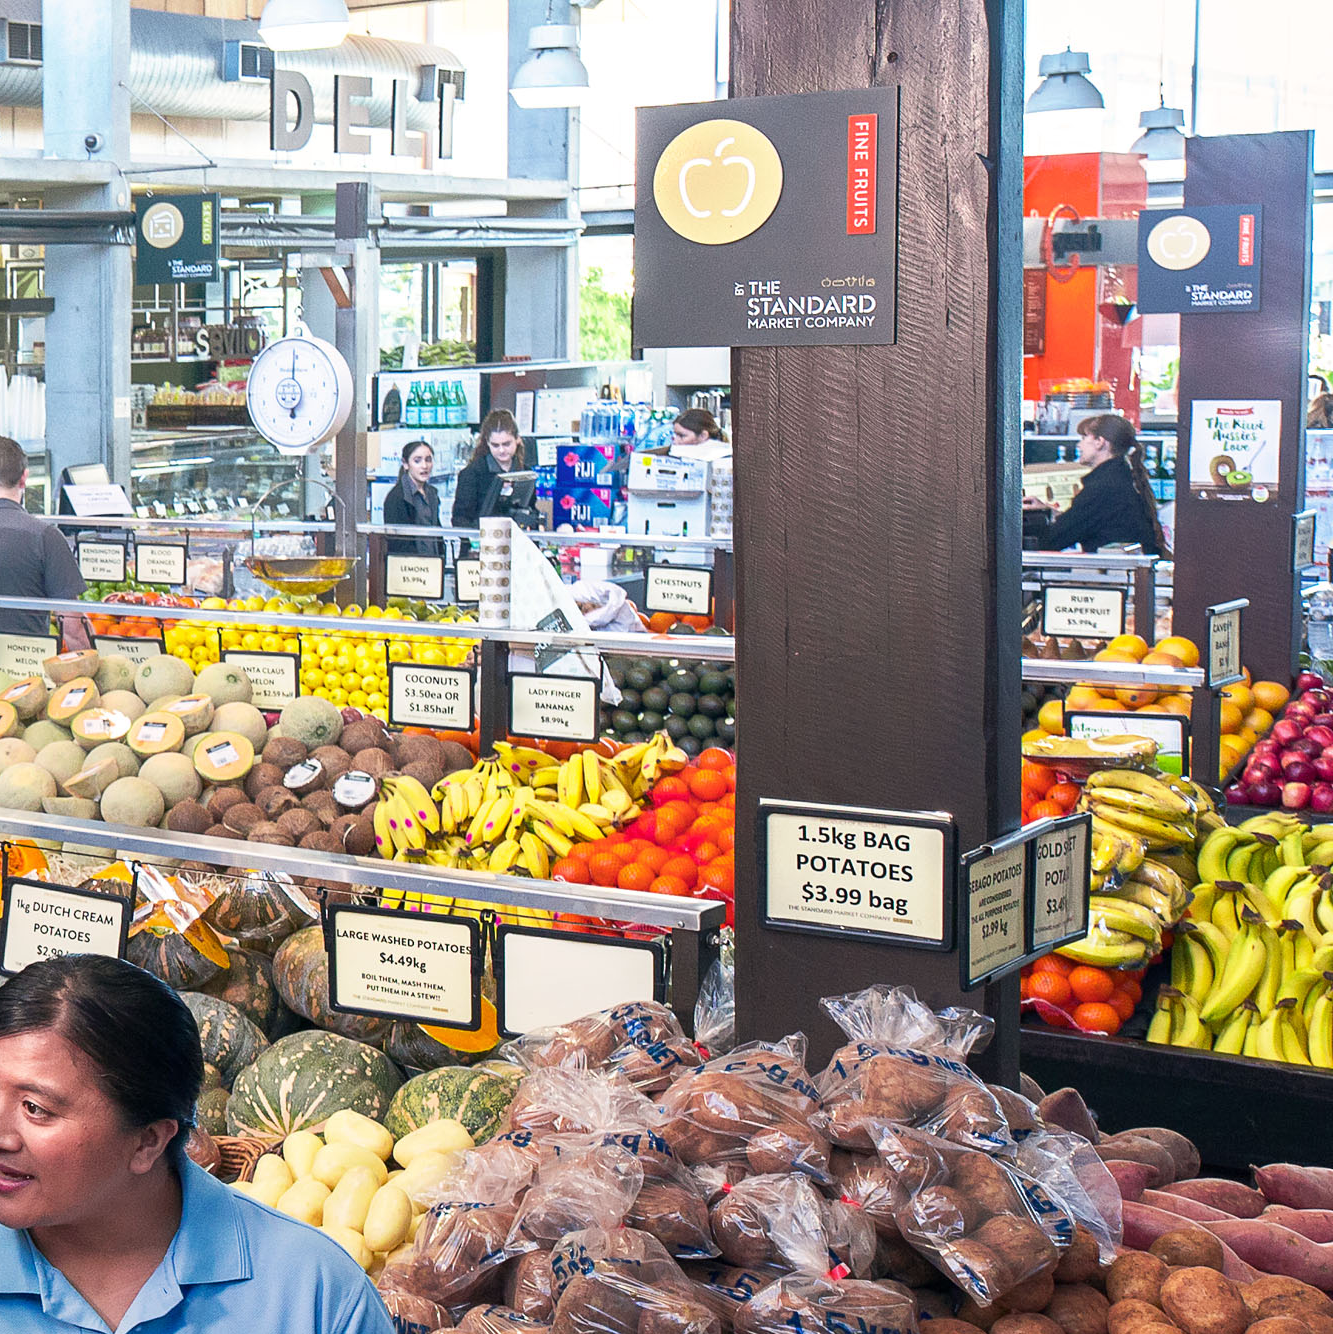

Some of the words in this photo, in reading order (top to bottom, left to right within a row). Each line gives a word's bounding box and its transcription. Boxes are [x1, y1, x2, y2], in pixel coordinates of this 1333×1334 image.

[855, 121, 869, 160] FINE
[854, 168, 869, 228] FRUITS
[172, 264, 212, 273] STANDARD
[735, 282, 744, 296] BY
[749, 280, 781, 295] THE
[1191, 290, 1253, 300] STANDARD
[747, 294, 876, 316] STANDARD
[747, 316, 801, 329] MARKET
[805, 316, 875, 328] COMPANY
[575, 462, 595, 478] FIJI
[571, 506, 591, 521] FIJI
[400, 564, 430, 574] LEMONS
[654, 577, 703, 590] CHESTNUTS
[1070, 595, 1095, 603] RUBY
[1054, 606, 1110, 616] GRAPEFRUIT
[7, 645, 27, 653] HONEY
[263, 667, 285, 675] CLAUS
[405, 674, 459, 686] COCONUTS
[405, 688, 442, 701] $3.50ea
[445, 691, 459, 700] OR
[529, 688, 548, 696] LADY
[551, 690, 581, 699] FINGER
[409, 703, 454, 715] $1.85half
[535, 702, 575, 712] BANANAS
[540, 716, 569, 727] $8.99kg
[798, 825, 857, 849] 1.5kg
[863, 832, 911, 852] BAG
[1037, 842, 1063, 860] GOLD
[796, 854, 914, 882] POTATOES
[993, 863, 1022, 884] POTATOES
[802, 882, 862, 905] $3.99
[869, 892, 909, 917] bag
[16, 898, 31, 914] 1kg
[32, 902, 72, 920] DUTCH
[73, 908, 115, 927] CREAM
[801, 906, 833, 915] STANDARD
[33, 922, 91, 944] POTATOES
[982, 920, 998, 939] $2.99
[1000, 918, 1008, 936] kg
[337, 929, 368, 941] LARGE
[371, 933, 415, 947] WASHED
[417, 940, 472, 955] POTATOES
[380, 952, 426, 973] $4.49kg
[362, 973, 378, 981] BOIL
[379, 976, 400, 985] THEM,
[424, 983, 446, 992] THEM,
[381, 987, 399, 996] THEM
[417, 992, 441, 1001] STEW!!
